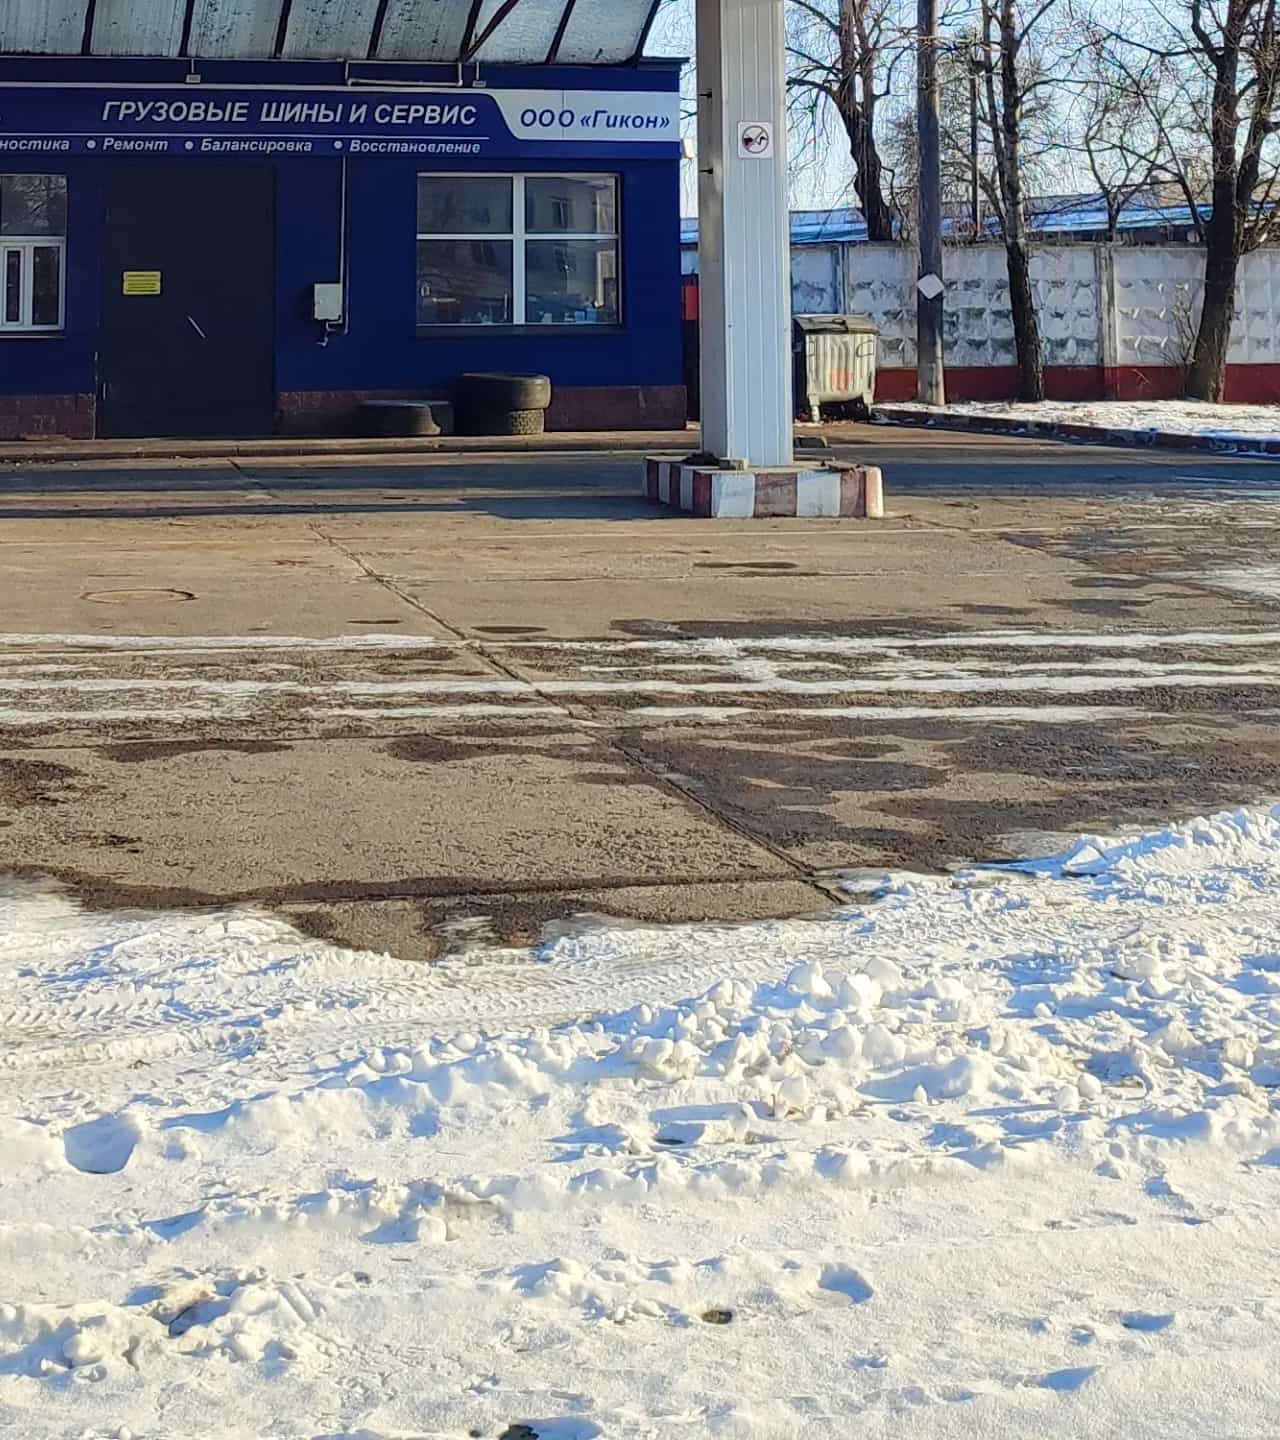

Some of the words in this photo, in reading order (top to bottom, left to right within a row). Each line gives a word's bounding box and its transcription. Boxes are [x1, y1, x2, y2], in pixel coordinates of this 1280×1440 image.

[102, 101, 250, 122] ГРУЗОВЫЕ
[260, 102, 343, 124] ШИНЫ
[349, 104, 368, 123] И
[374, 105, 477, 125] СЕРВИС
[520, 109, 575, 128] ООО
[580, 110, 671, 129] «Гикон»
[103, 137, 168, 151] Ремонт
[201, 138, 312, 153] Балансировка
[349, 139, 480, 153] Восстановление
